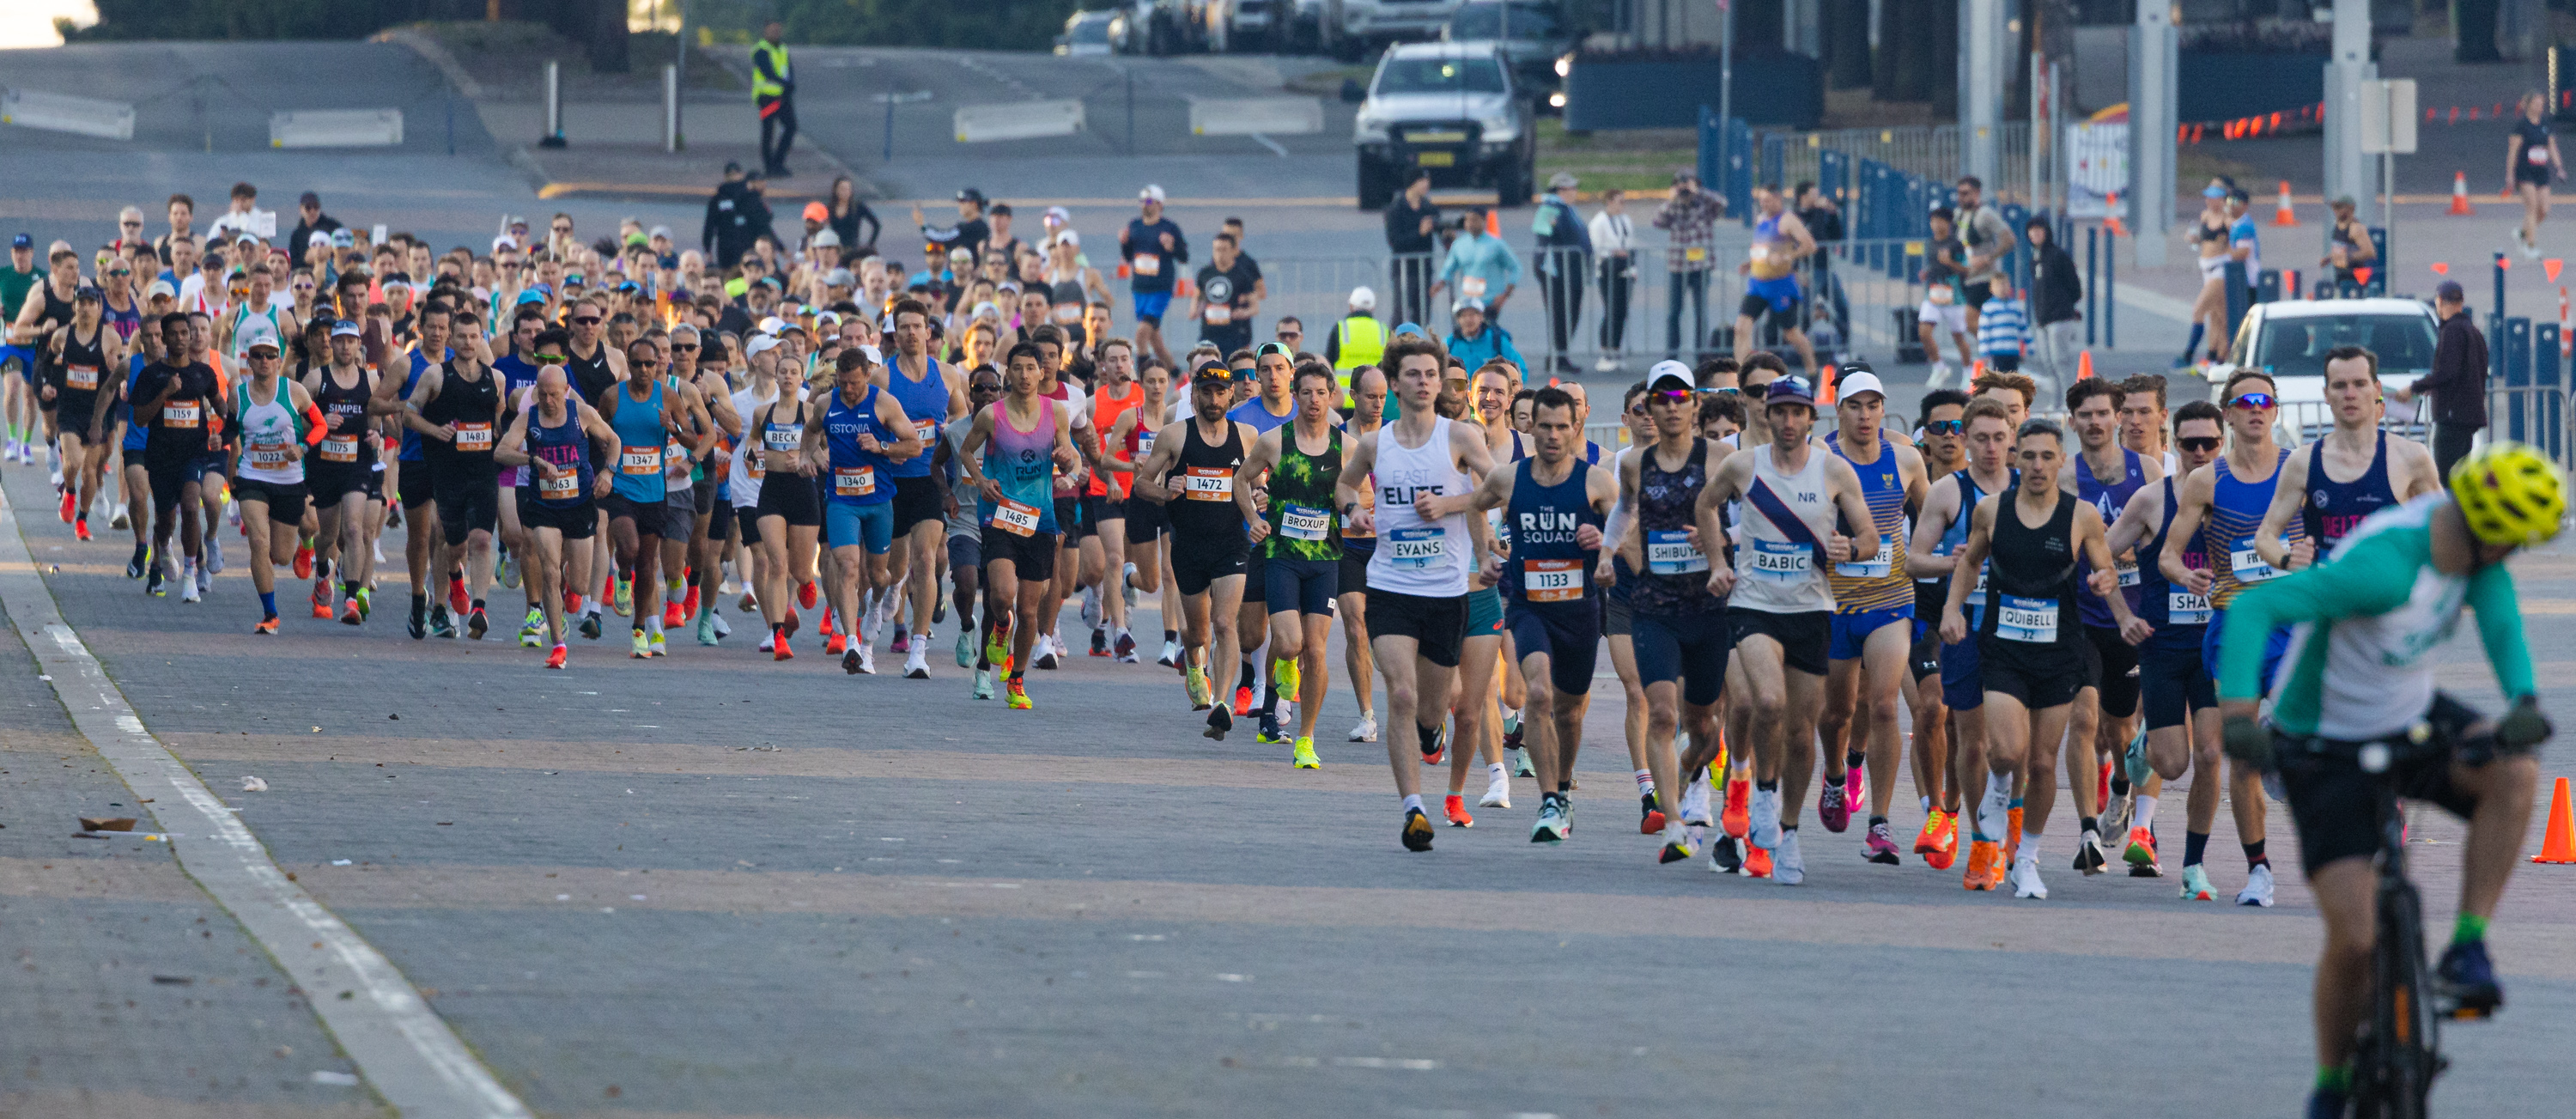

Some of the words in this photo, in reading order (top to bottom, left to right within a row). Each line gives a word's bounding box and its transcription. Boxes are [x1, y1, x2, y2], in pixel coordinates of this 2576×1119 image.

[329, 403, 362, 414] SIMPEL
[173, 410, 191, 419] 1159
[829, 423, 871, 434] ESTONIA
[465, 432, 485, 441] 1483
[772, 433, 797, 442] BECK
[330, 442, 349, 453] 1175
[258, 452, 280, 462] 1022
[536, 444, 580, 466] DELTA
[631, 455, 653, 465] 1347
[1016, 464, 1042, 476] RUN
[842, 476, 866, 486] 1340
[1393, 469, 1430, 485] EAST
[548, 478, 570, 490] 1063
[1196, 478, 1223, 490] 1472
[1797, 492, 1817, 503] NR
[1005, 509, 1029, 526] 1485
[1287, 515, 1325, 529] BROXUP
[1520, 513, 1577, 531] RUN
[1523, 531, 1577, 544] SQUAD
[1395, 541, 1440, 556] EVANS
[1414, 558, 1425, 569] 15
[1759, 555, 1806, 569] BABIC
[1862, 566, 1869, 575] 3
[2258, 567, 2272, 578] 44
[1539, 573, 1569, 587] 1133
[1779, 572, 1784, 582] 1
[2118, 574, 2130, 586] 22
[2005, 611, 2051, 626] QUIBELL
[2195, 611, 2206, 623] 36
[2020, 629, 2035, 640] 32
